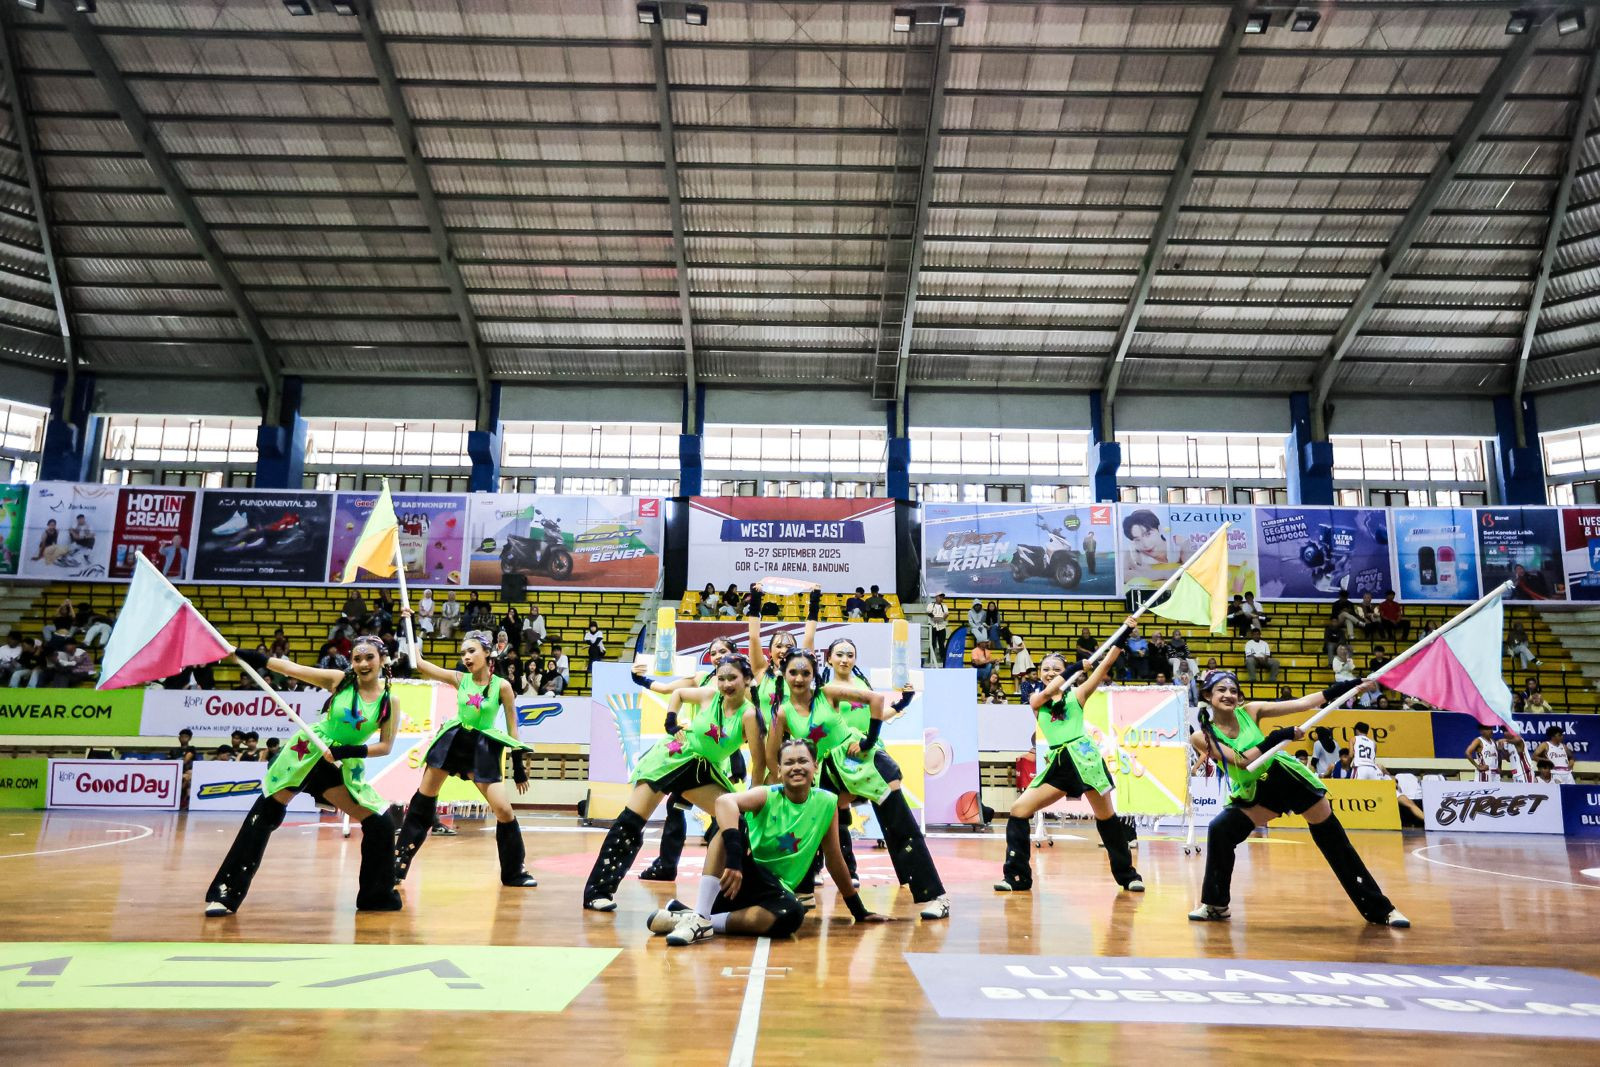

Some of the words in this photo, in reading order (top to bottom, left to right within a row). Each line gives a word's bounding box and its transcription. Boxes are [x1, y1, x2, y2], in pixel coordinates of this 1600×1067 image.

[127, 493, 164, 512] HOT
[164, 494, 182, 512] IN
[240, 500, 303, 508] FUNDAMENTAL
[401, 501, 458, 509] BABYMONSTER
[125, 512, 180, 528] CREAM
[740, 523, 775, 538] WEST
[779, 523, 846, 539] JAVA-EAST
[1264, 522, 1308, 536] SEGERNYA
[589, 548, 646, 563] BENER
[744, 548, 770, 558] 13-27
[772, 548, 816, 559] SEPTEMBER
[818, 549, 841, 559] 2025
[735, 562, 751, 572] GOR
[754, 562, 779, 573] C-TRA
[781, 562, 810, 574] ARENA,
[812, 562, 850, 573] BANDUNG
[947, 556, 997, 573] KAN!
[205, 695, 258, 717] Good
[75, 772, 128, 793] Good
[130, 773, 170, 799] Day
[1435, 794, 1550, 827] STREET
[1004, 965, 1291, 984] ULTRA
[1287, 970, 1534, 991] MILK
[979, 986, 1391, 1009] BLUEBERRY
